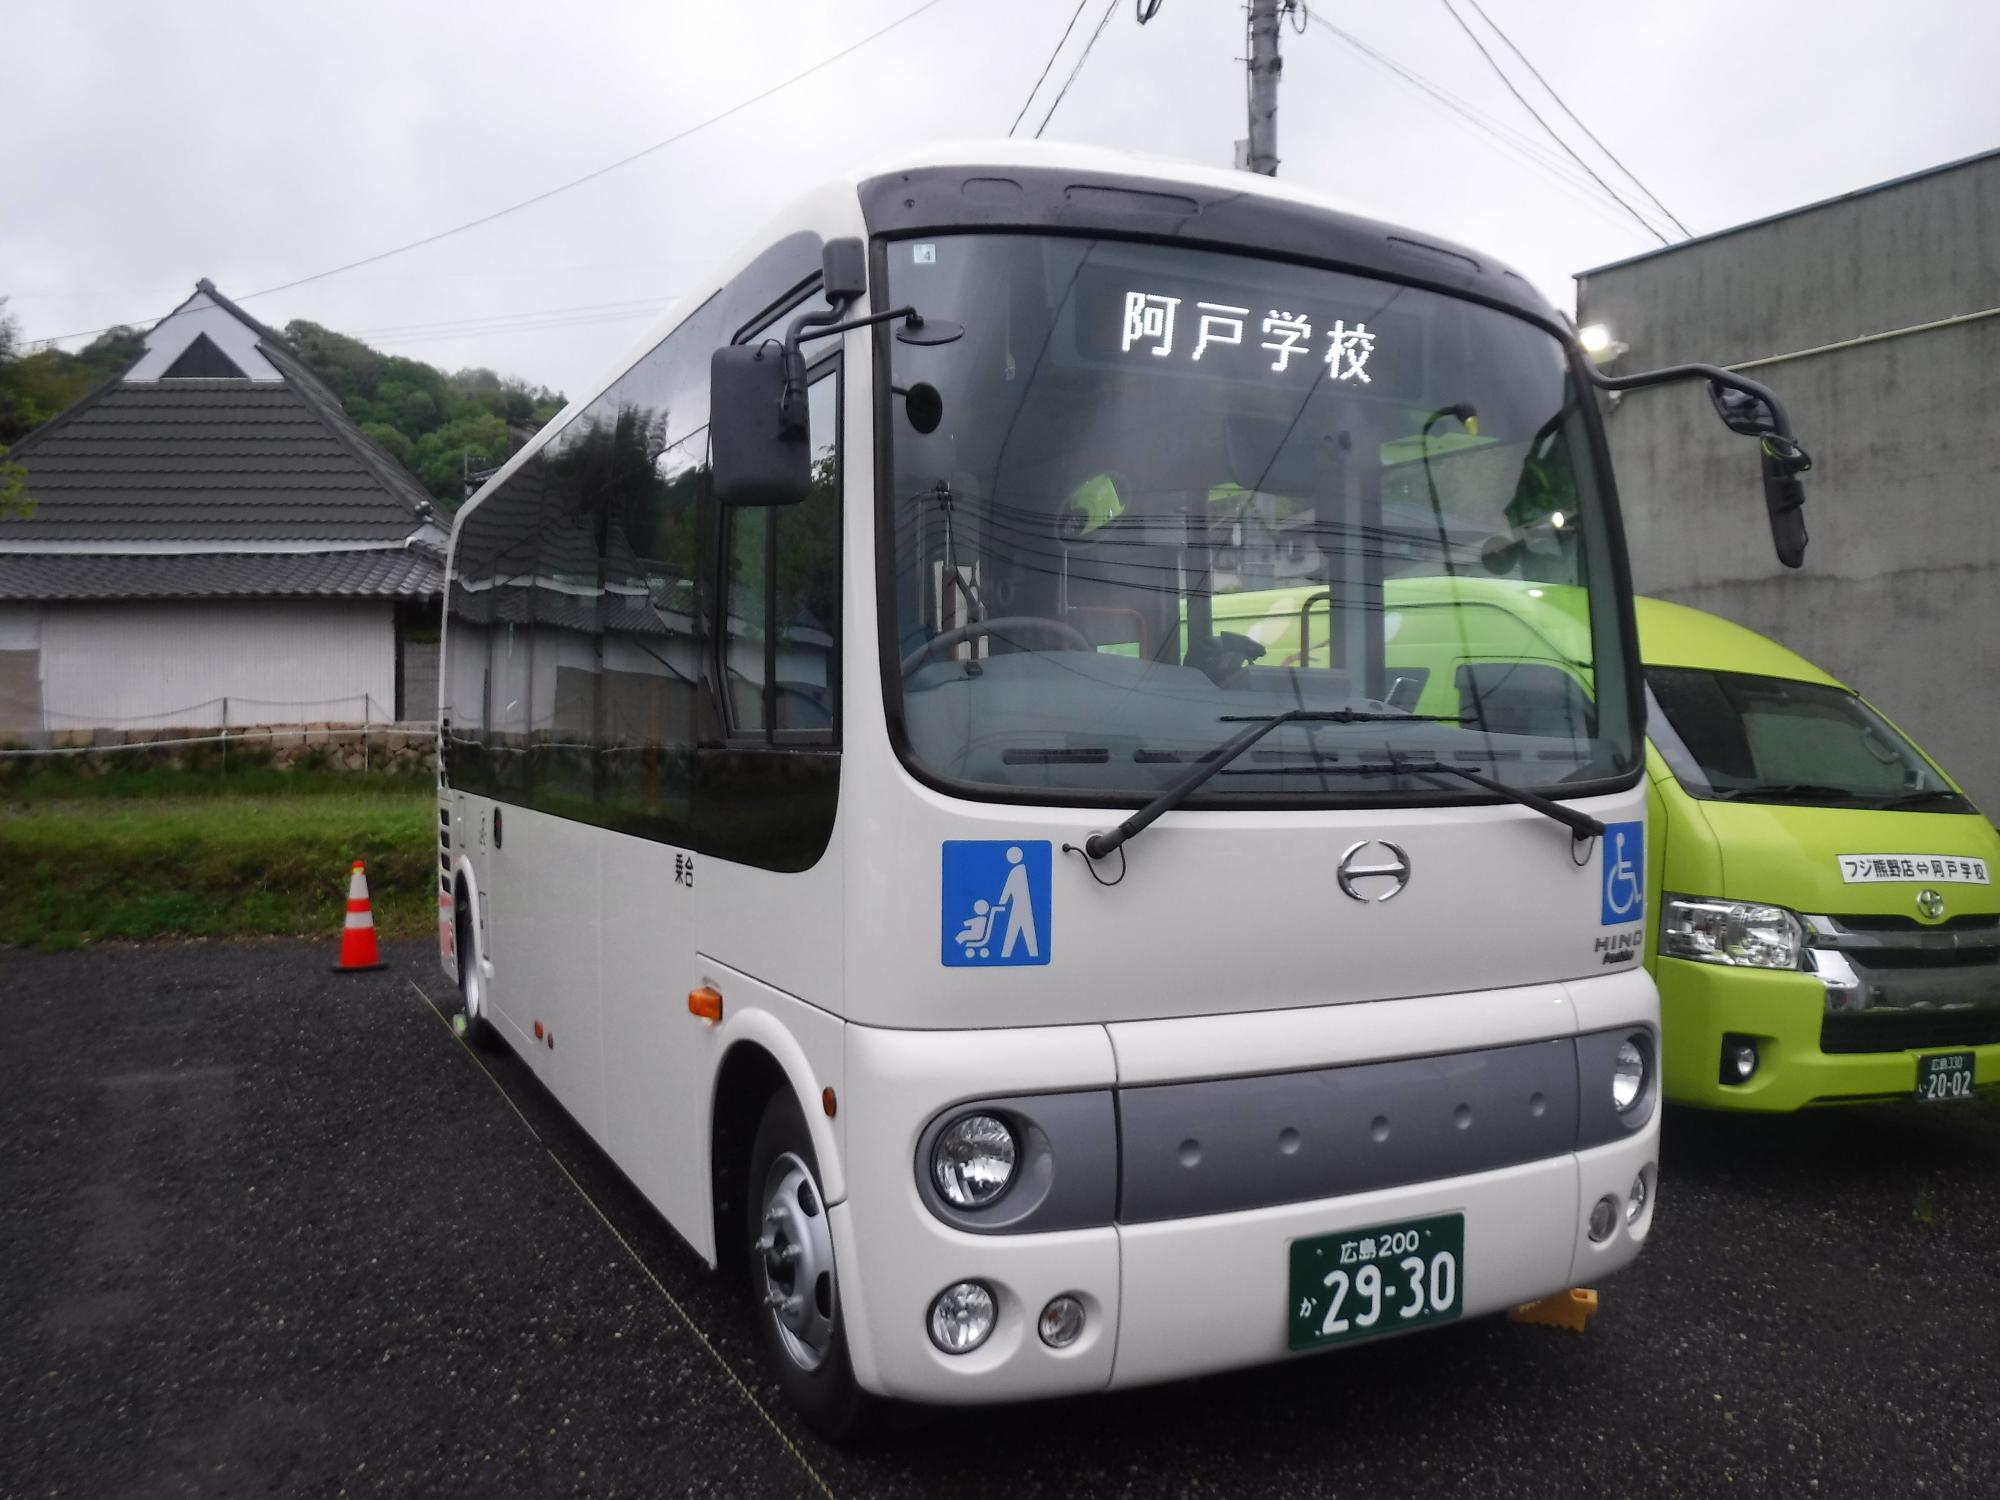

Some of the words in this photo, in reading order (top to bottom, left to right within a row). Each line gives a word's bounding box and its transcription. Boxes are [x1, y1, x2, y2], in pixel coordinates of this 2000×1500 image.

[1121, 290, 1377, 384] 阿戸学校
[1321, 1250, 1457, 1335] 29-30
